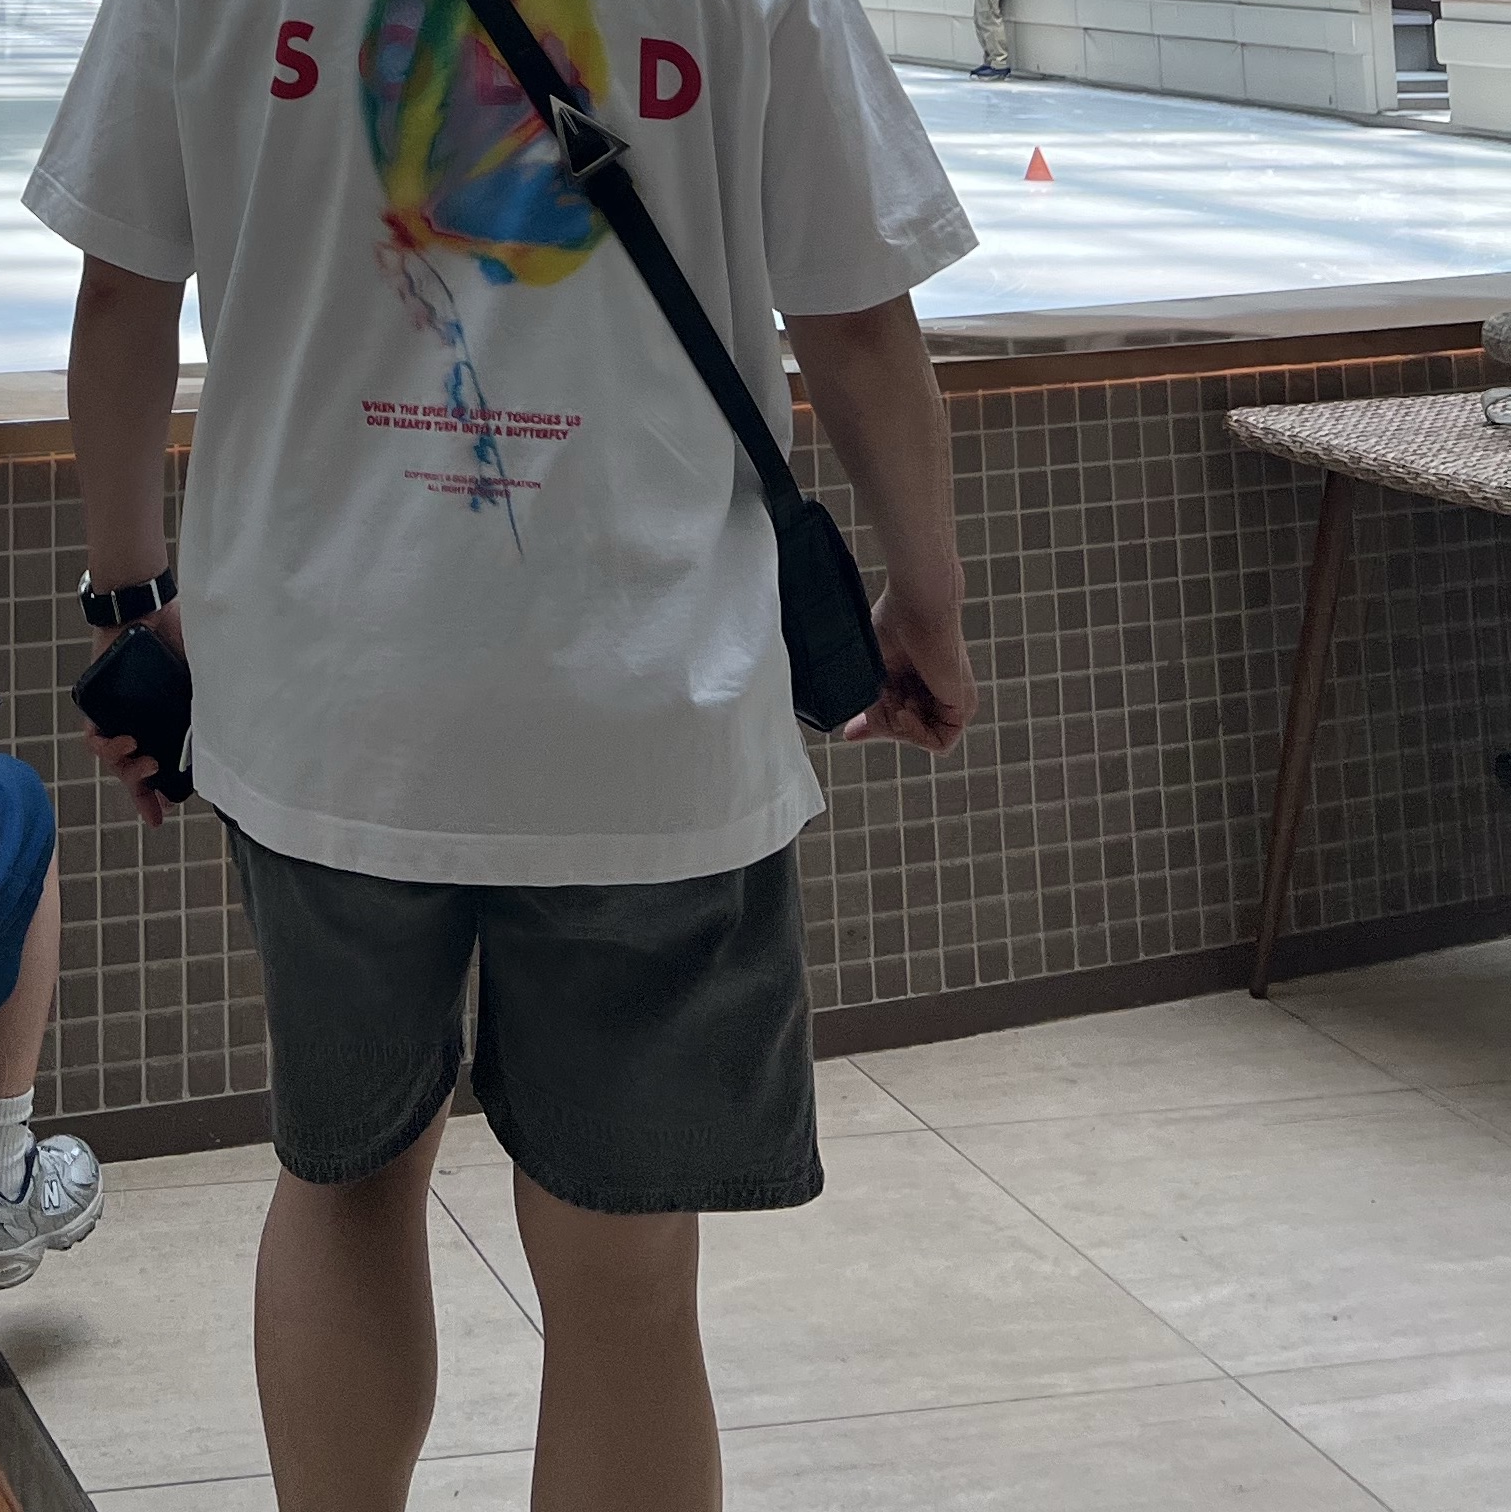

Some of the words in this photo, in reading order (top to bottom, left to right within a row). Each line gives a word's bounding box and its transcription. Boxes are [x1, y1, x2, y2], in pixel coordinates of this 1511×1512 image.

[361, 400, 395, 414] WHEN
[399, 403, 419, 416] THE
[505, 411, 561, 426] TOUCHES
[565, 415, 582, 427] US
[366, 415, 390, 427] OUR
[393, 418, 432, 431] HEARTS
[461, 423, 490, 436] INTO
[493, 426, 503, 437] A
[505, 426, 569, 440] BUTTERFLY
[43, 1179, 61, 1210] N
